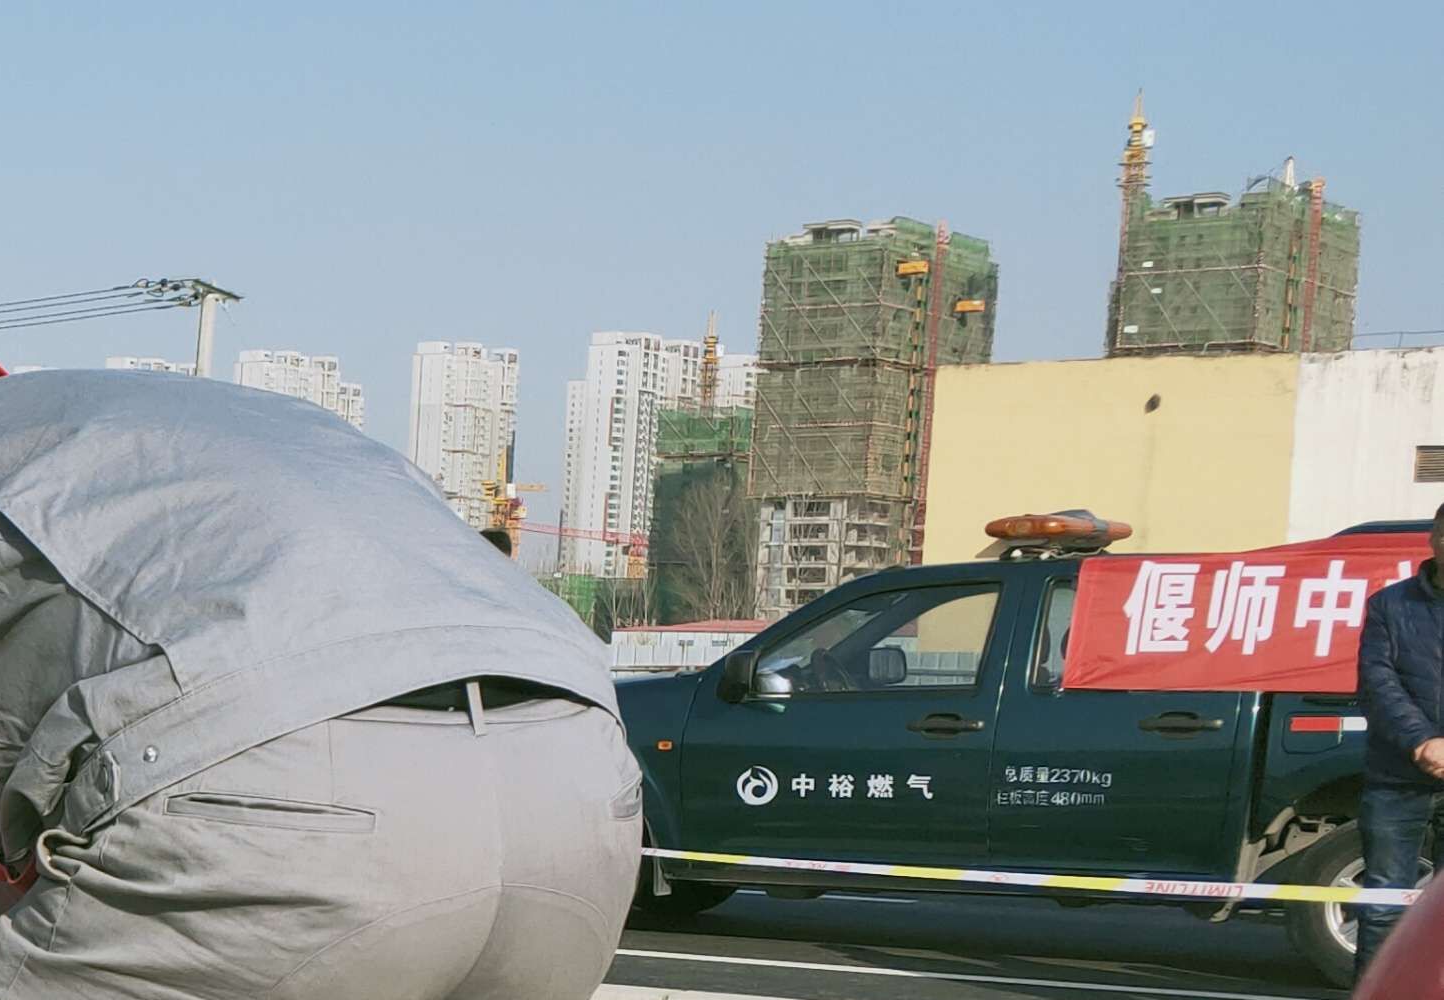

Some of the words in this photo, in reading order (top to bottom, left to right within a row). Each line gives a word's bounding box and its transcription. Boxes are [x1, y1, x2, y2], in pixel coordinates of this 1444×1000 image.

[1123, 560, 1414, 657] 偃师中
[791, 774, 933, 800] 中裕燃气
[1145, 881, 1243, 898] LIMITLINE
